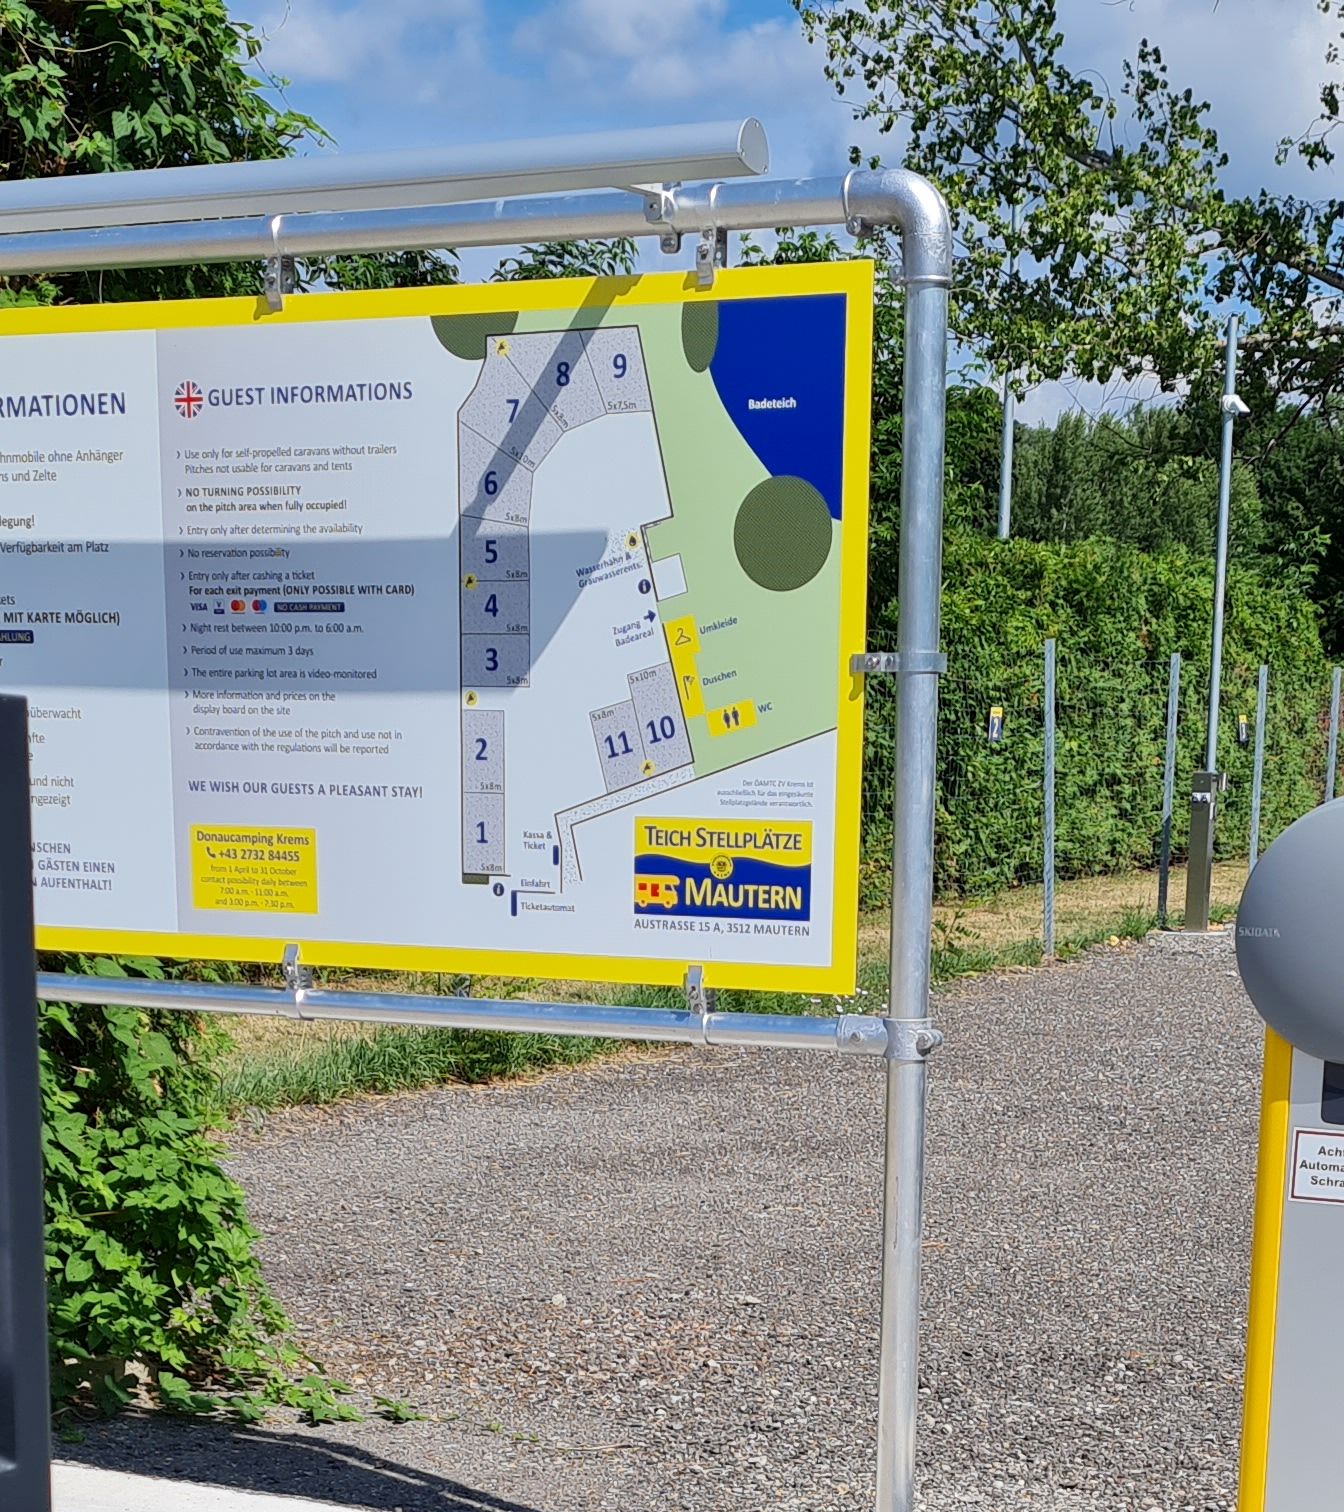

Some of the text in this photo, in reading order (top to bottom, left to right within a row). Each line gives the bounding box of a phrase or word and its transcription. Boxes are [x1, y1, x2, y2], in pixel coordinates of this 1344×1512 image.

[556, 362, 570, 386] 8
[613, 354, 627, 378] 9
[209, 381, 413, 407] GUEST INFORMATIONS
[748, 397, 796, 409] Badeteich
[506, 399, 519, 423] 7
[607, 402, 637, 411] 5x7,5m
[185, 486, 301, 497] NO TURNING POSSIBILITY
[484, 471, 498, 495] 6
[186, 500, 347, 514] on the pitch area when fully occupied!
[485, 540, 498, 563] 5
[576, 556, 624, 577] Wasserhahn
[189, 584, 415, 597] For each exit payment (ONLY POSSIBLE WITH CARD)
[484, 594, 499, 617] 4
[4, 612, 25, 623] MIT
[27, 612, 62, 623] KARTE
[65, 610, 120, 625] MÖGLICH)
[699, 616, 738, 635] Umkleide
[612, 621, 641, 635] Zugang
[615, 629, 654, 647] Badeareal
[485, 648, 498, 671] 3
[702, 670, 737, 686] Duschen
[758, 702, 773, 713] WC
[646, 715, 675, 744] 10
[475, 737, 488, 761] 2
[604, 731, 633, 758] 11
[188, 780, 422, 798] WE WISH OUR GUESTS A PLEASANT STAY!
[196, 831, 310, 846] Donaucamping Krems
[476, 821, 488, 844] 1
[644, 825, 802, 850] TEICH STELLPLÄTZE
[523, 842, 545, 850] Ticket
[219, 849, 299, 862] +43 2732 84455
[38, 857, 115, 873] GÄSTEN EINEN
[41, 877, 112, 890] AUFENTHALT!
[685, 878, 801, 910] MAUTERN
[634, 919, 810, 936] AUSTRASSE 15 A, 3512 MAUTERN
[1239, 927, 1280, 938] SKIDATA
